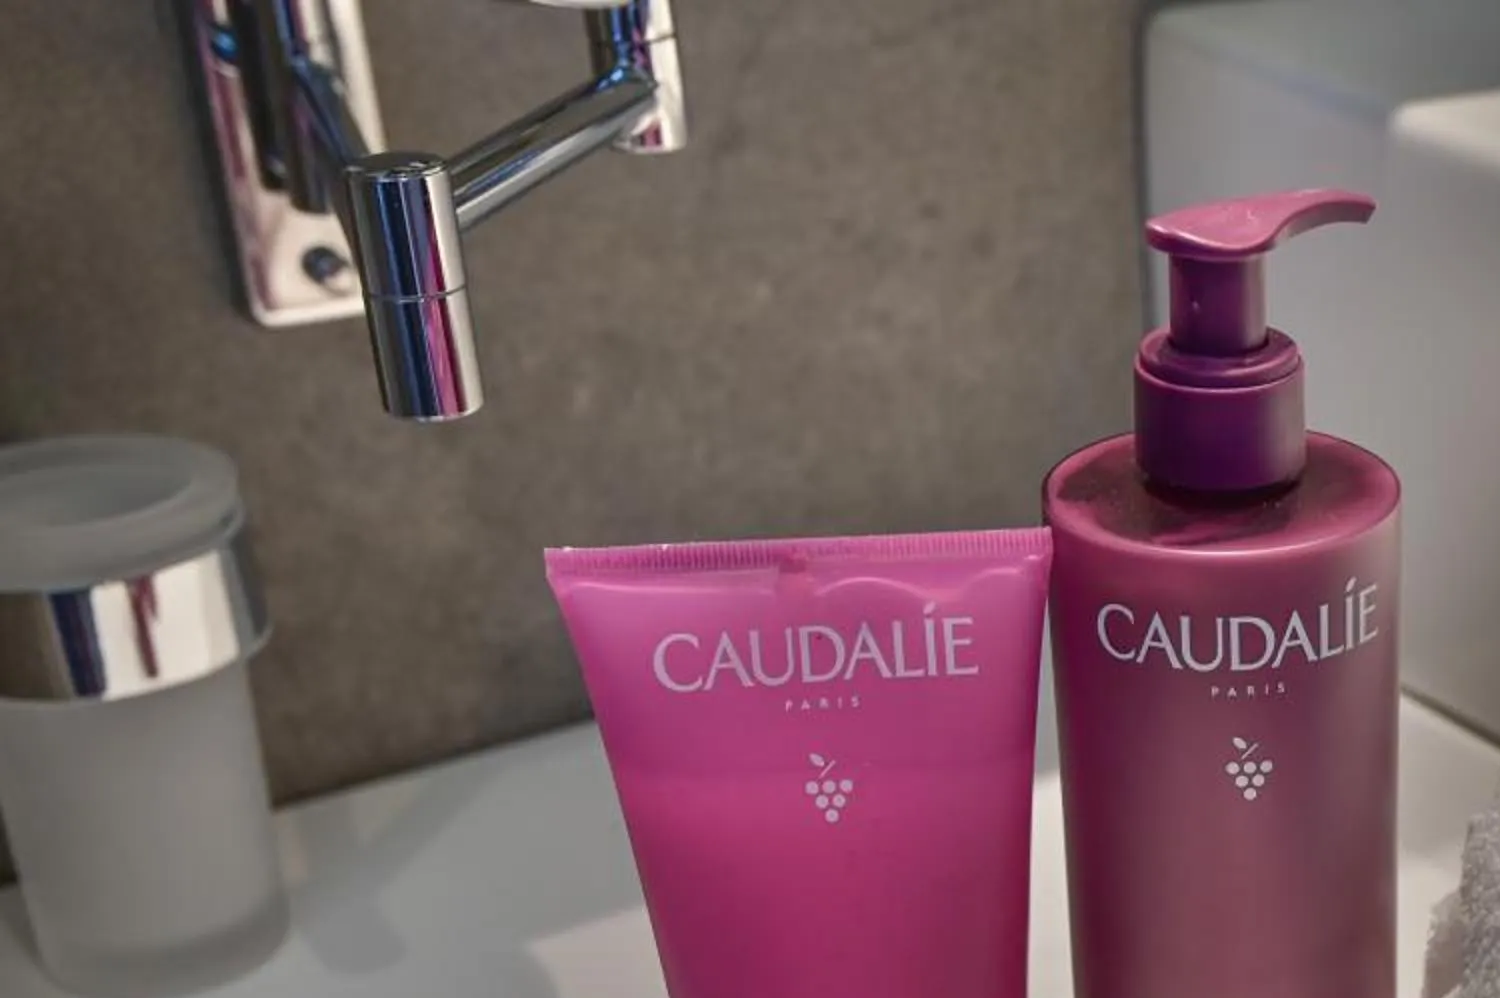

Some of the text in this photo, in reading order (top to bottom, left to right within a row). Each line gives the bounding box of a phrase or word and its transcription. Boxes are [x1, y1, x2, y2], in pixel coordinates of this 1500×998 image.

[653, 602, 979, 692] CAUDALÍE
[1097, 577, 1379, 672] CAUDALÍE
[785, 696, 860, 712] PARIS
[1211, 682, 1285, 697] PARIS
